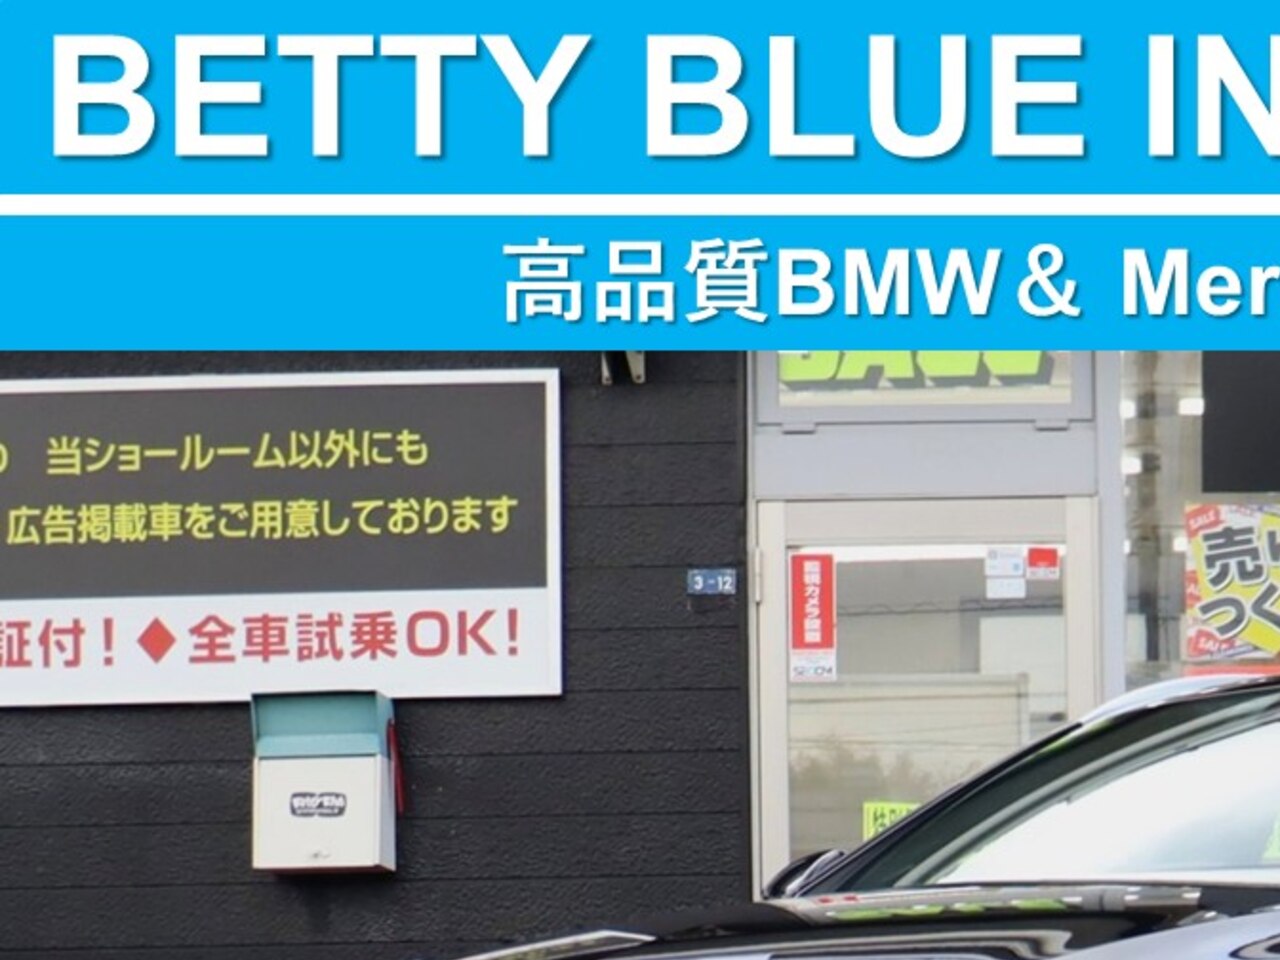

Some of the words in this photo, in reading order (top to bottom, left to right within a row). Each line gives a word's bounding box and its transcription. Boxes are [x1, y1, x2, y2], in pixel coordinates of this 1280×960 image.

[46, 428, 430, 477] 当ショールーム以外にも
[5, 495, 518, 547] 広告掲載車をご用意しております
